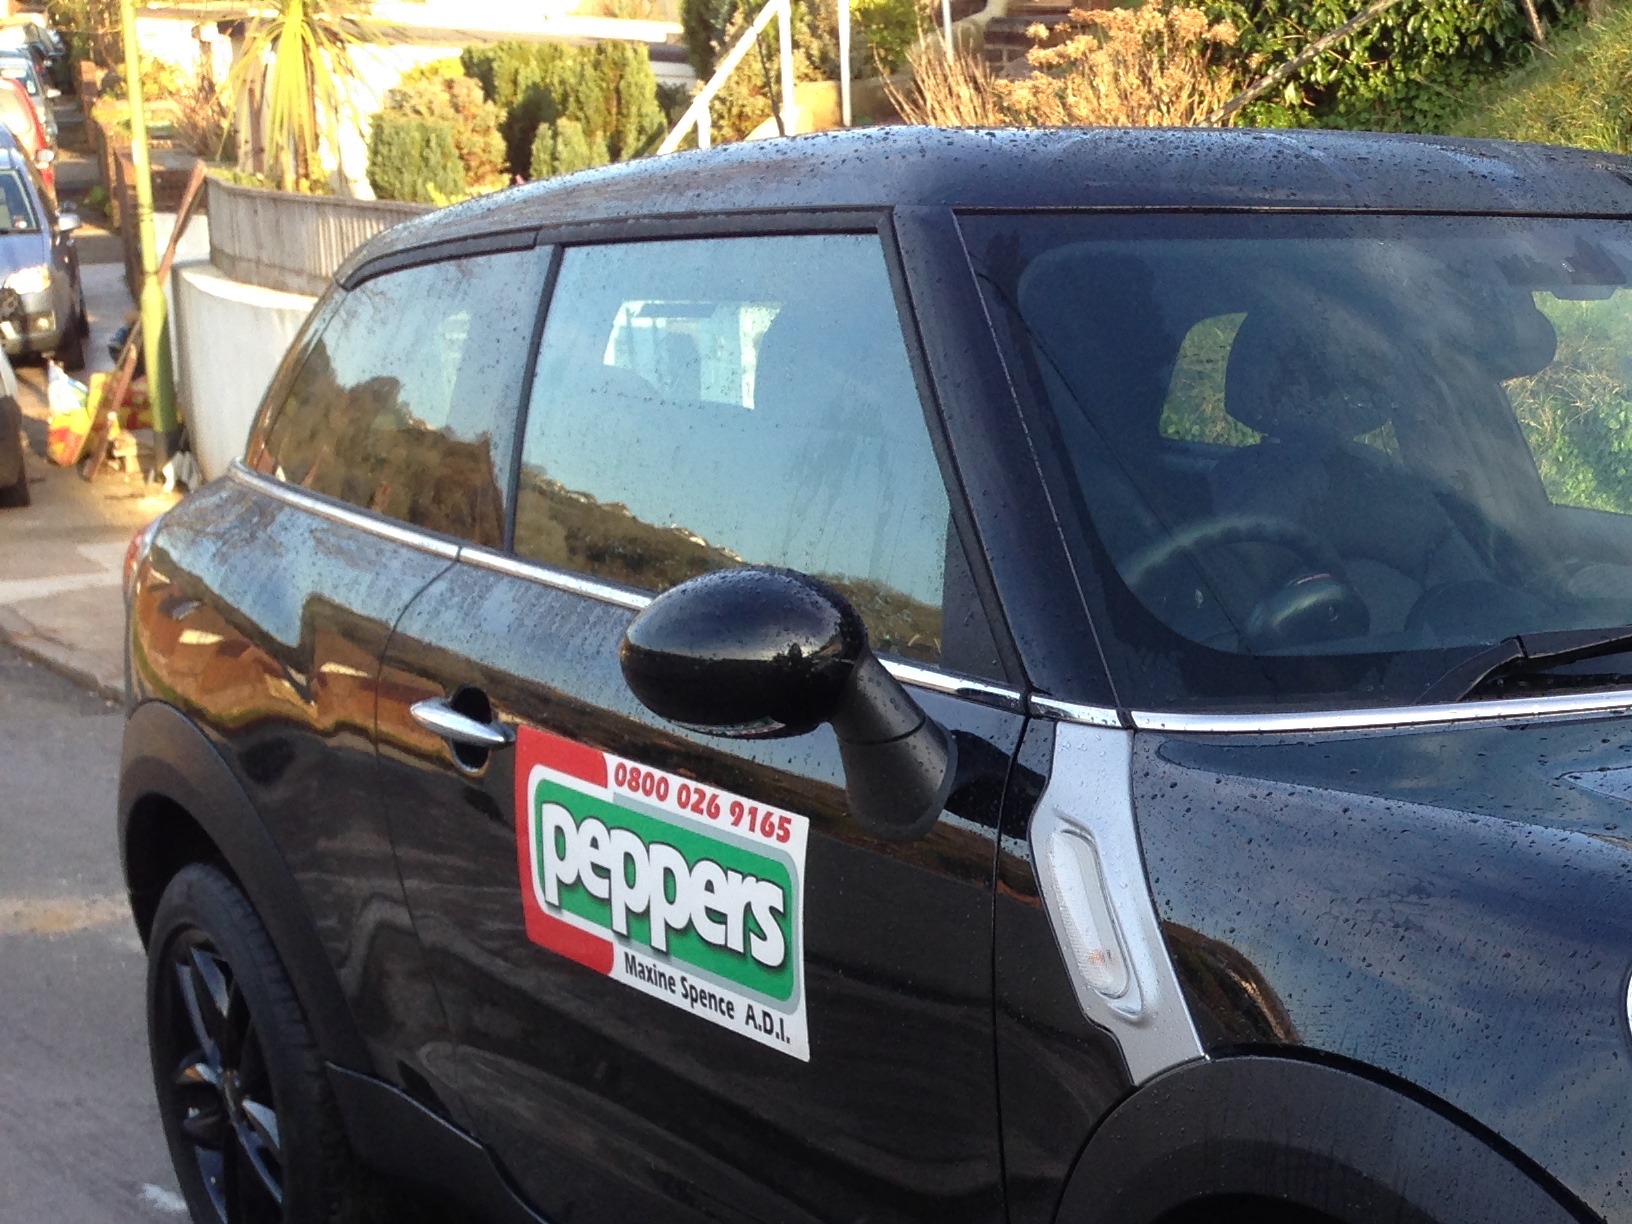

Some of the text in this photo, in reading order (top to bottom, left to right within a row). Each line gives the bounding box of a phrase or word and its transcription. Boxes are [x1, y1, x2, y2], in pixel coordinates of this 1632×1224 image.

[614, 762, 792, 844] 0800 026 9165
[541, 802, 786, 968] peppers
[624, 952, 791, 1044] Maxine Spence A.D.I.
